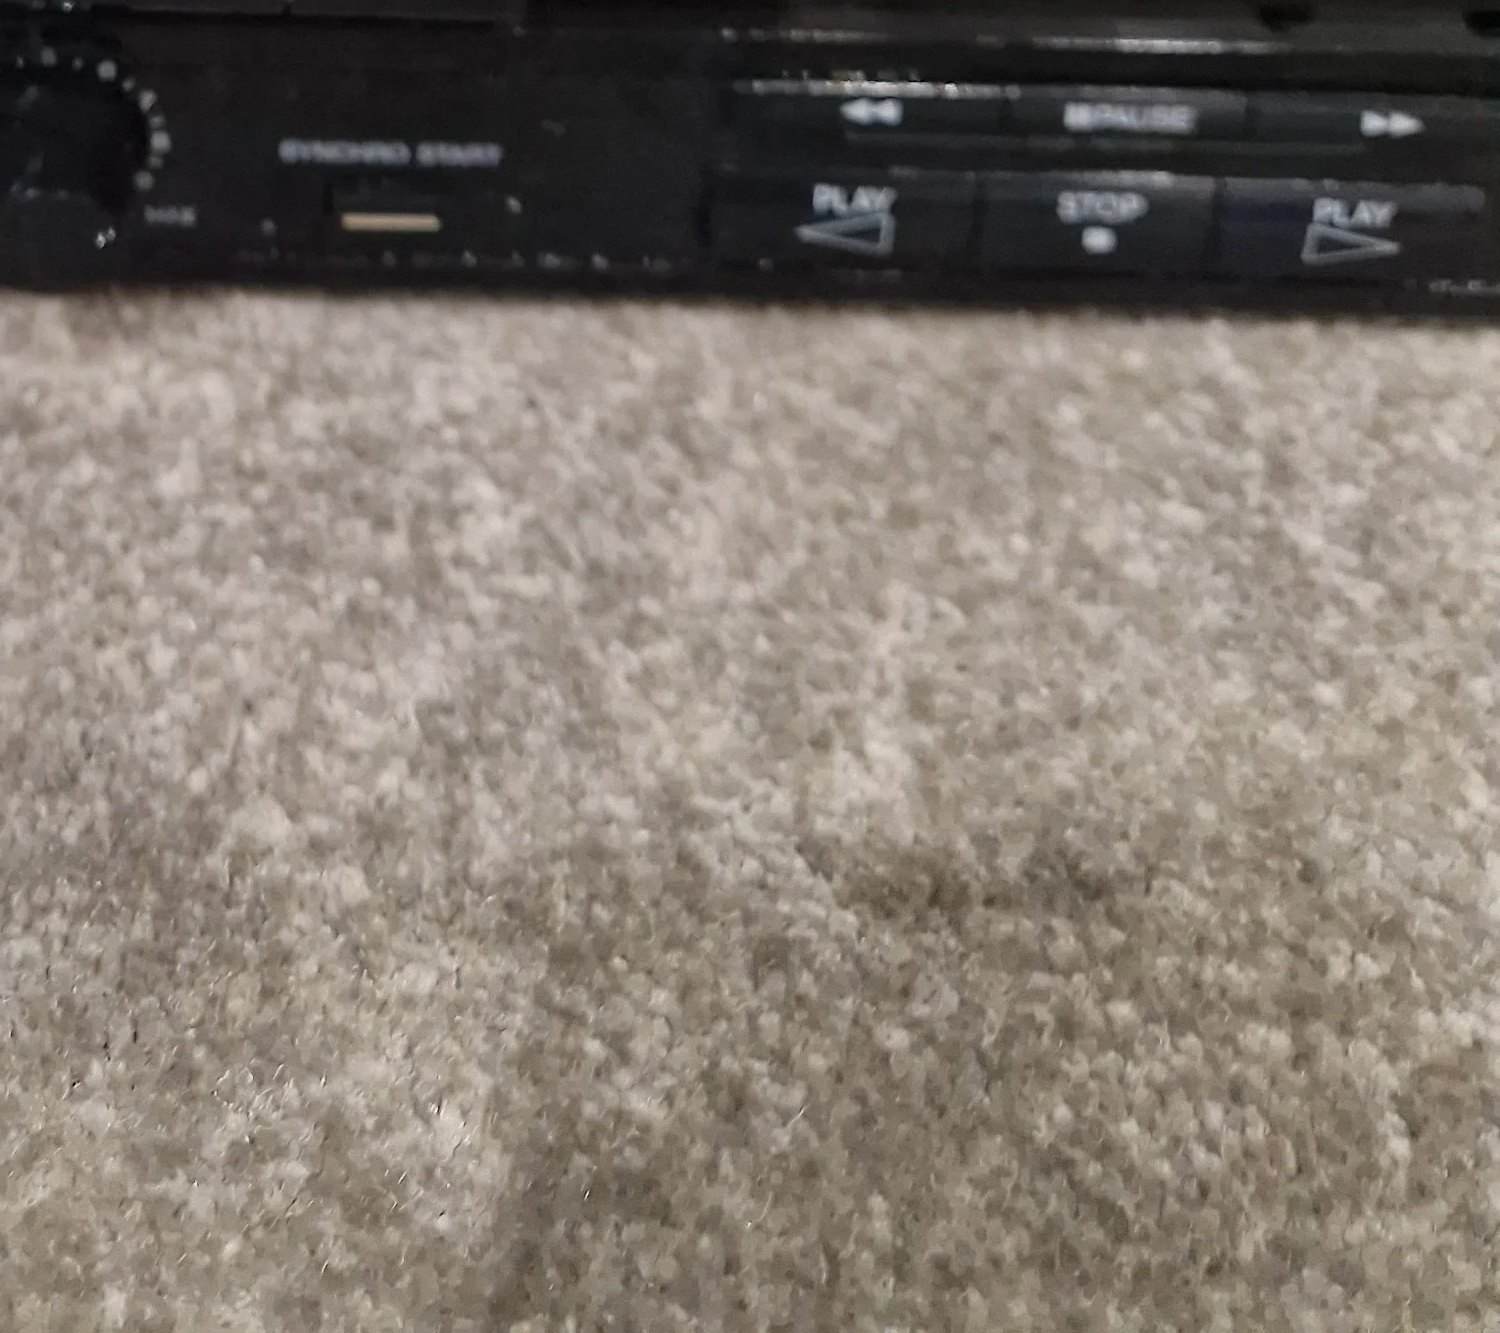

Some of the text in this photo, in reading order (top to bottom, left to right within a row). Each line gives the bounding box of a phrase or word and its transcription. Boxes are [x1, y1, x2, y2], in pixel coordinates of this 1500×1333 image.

[813, 184, 898, 214] PLAY
[1056, 191, 1149, 224] STOP
[1313, 198, 1397, 229] PLAY
